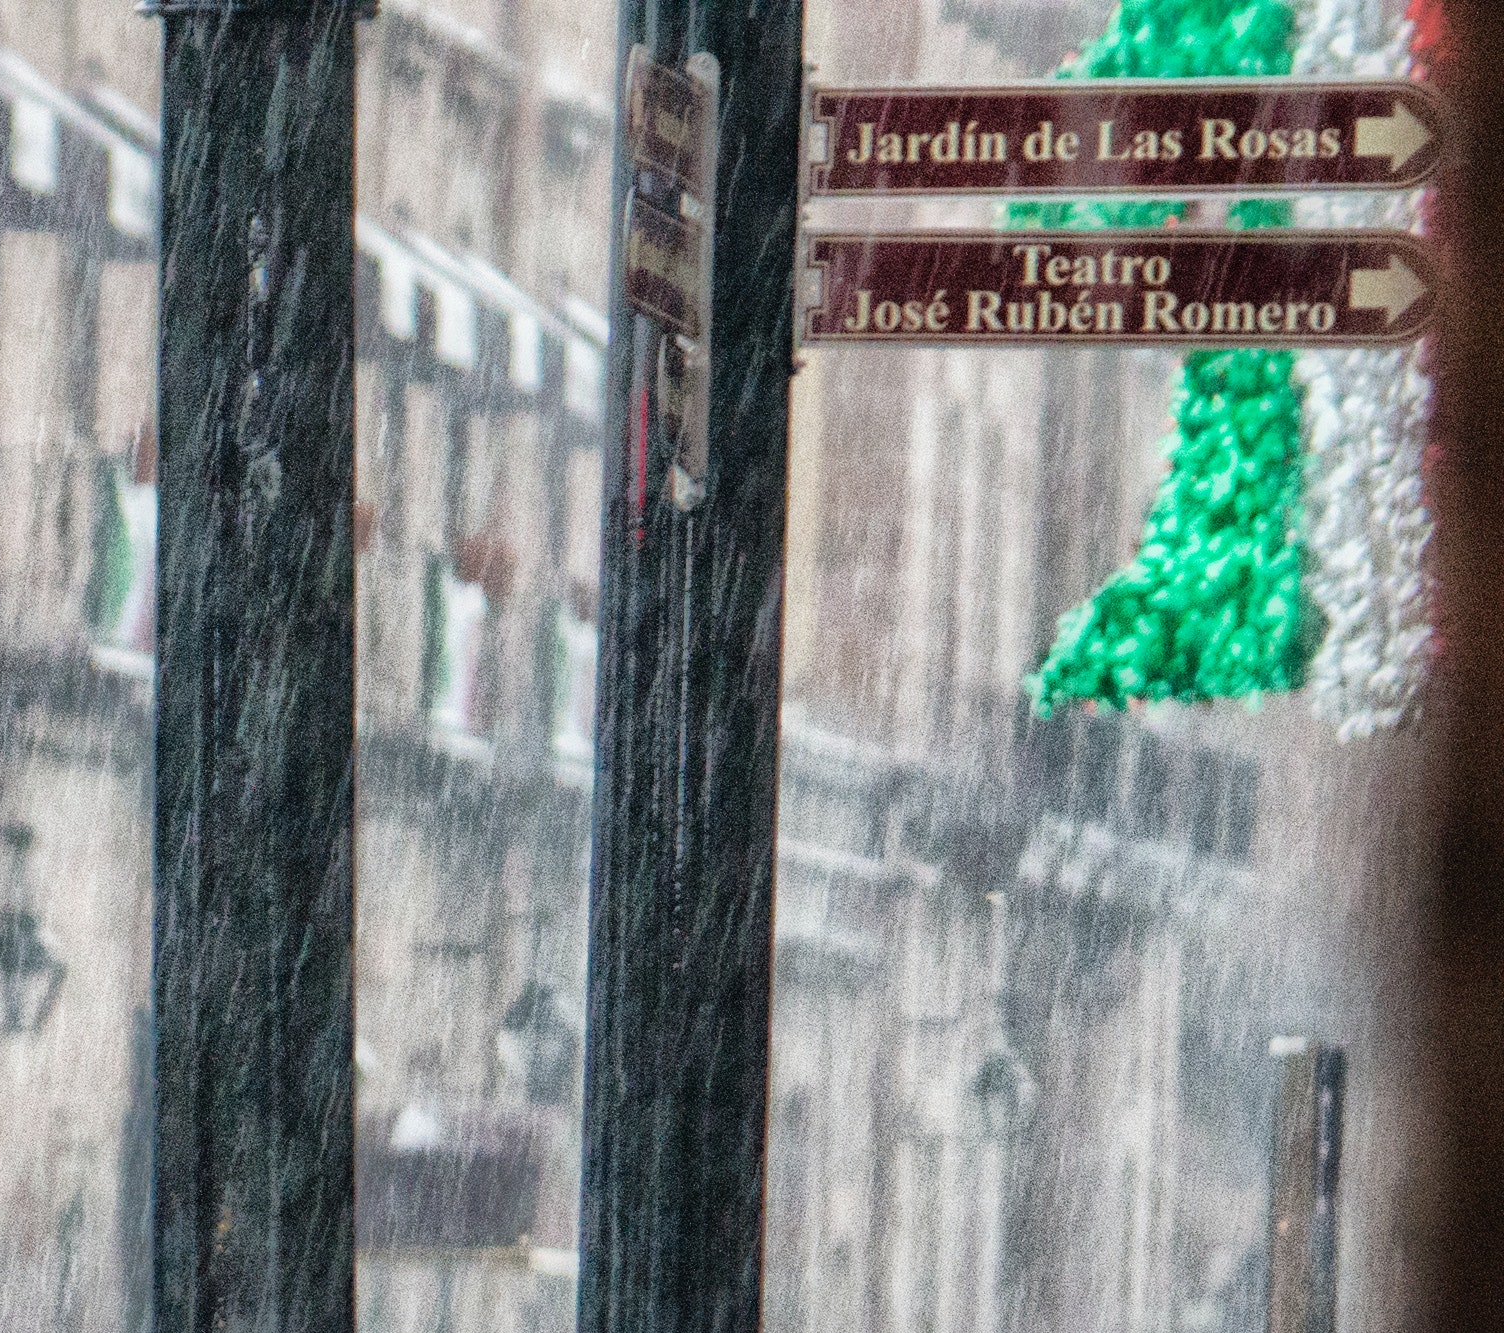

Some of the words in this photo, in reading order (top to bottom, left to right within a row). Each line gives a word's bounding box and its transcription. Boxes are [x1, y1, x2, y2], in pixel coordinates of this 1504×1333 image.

[846, 119, 1008, 165] Jardín
[1022, 120, 1081, 162] de
[1097, 119, 1183, 161] Las
[1198, 117, 1342, 159] Rosas
[1013, 244, 1173, 288] Teatro
[843, 289, 949, 333] José
[967, 289, 1125, 333] Rubén
[1141, 291, 1337, 334] Romero
